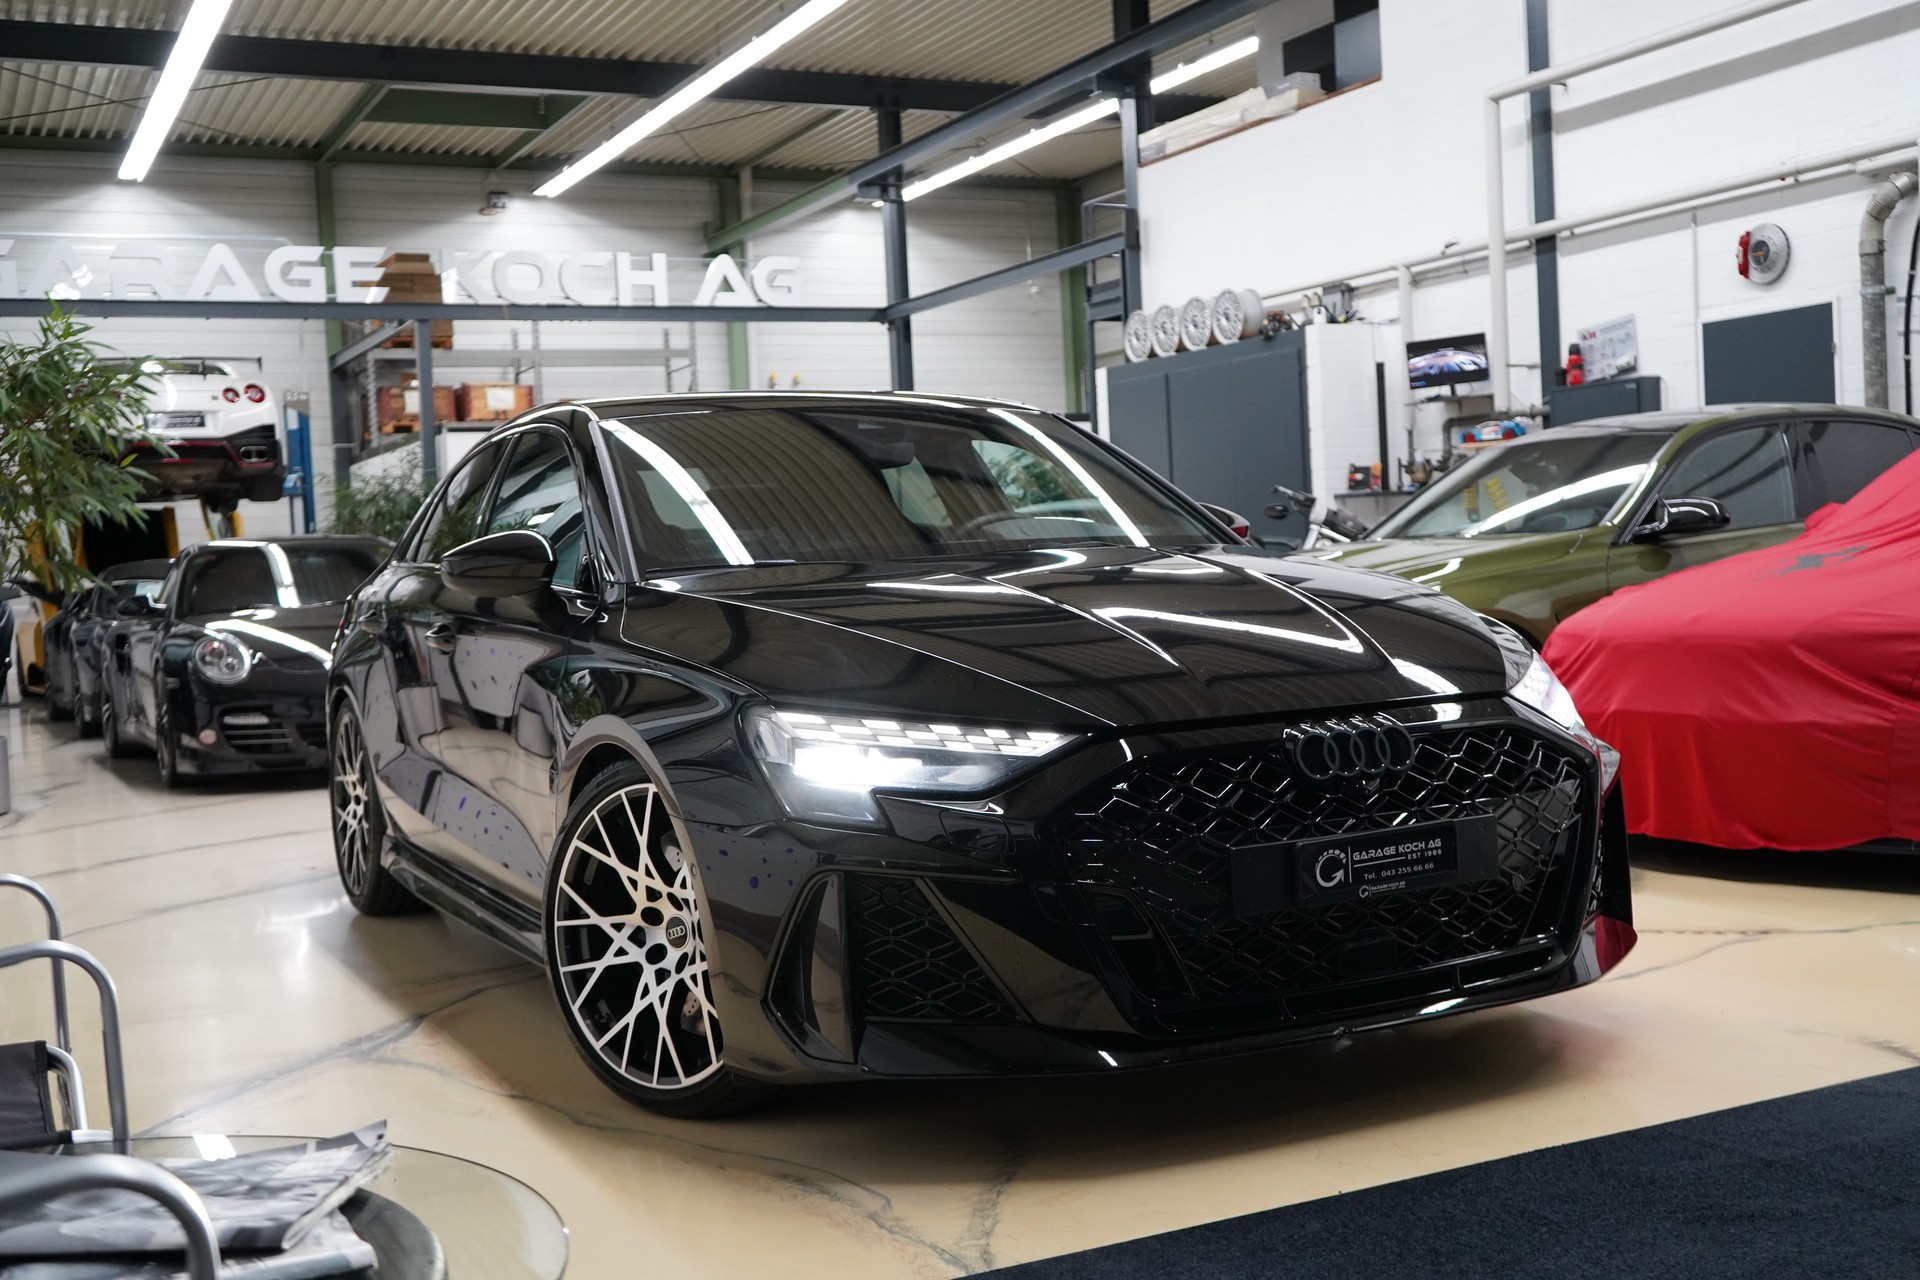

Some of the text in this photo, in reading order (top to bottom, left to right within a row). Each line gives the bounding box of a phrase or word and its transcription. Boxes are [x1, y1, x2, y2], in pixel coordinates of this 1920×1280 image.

[0, 239, 801, 306] ARAGE KOCH AG
[1353, 838, 1442, 861] GARAGE KOCH AG
[1425, 849, 1442, 857] 1986
[1364, 872, 1377, 880] Tel.
[1381, 869, 1396, 877] 043
[1397, 866, 1412, 875] 255
